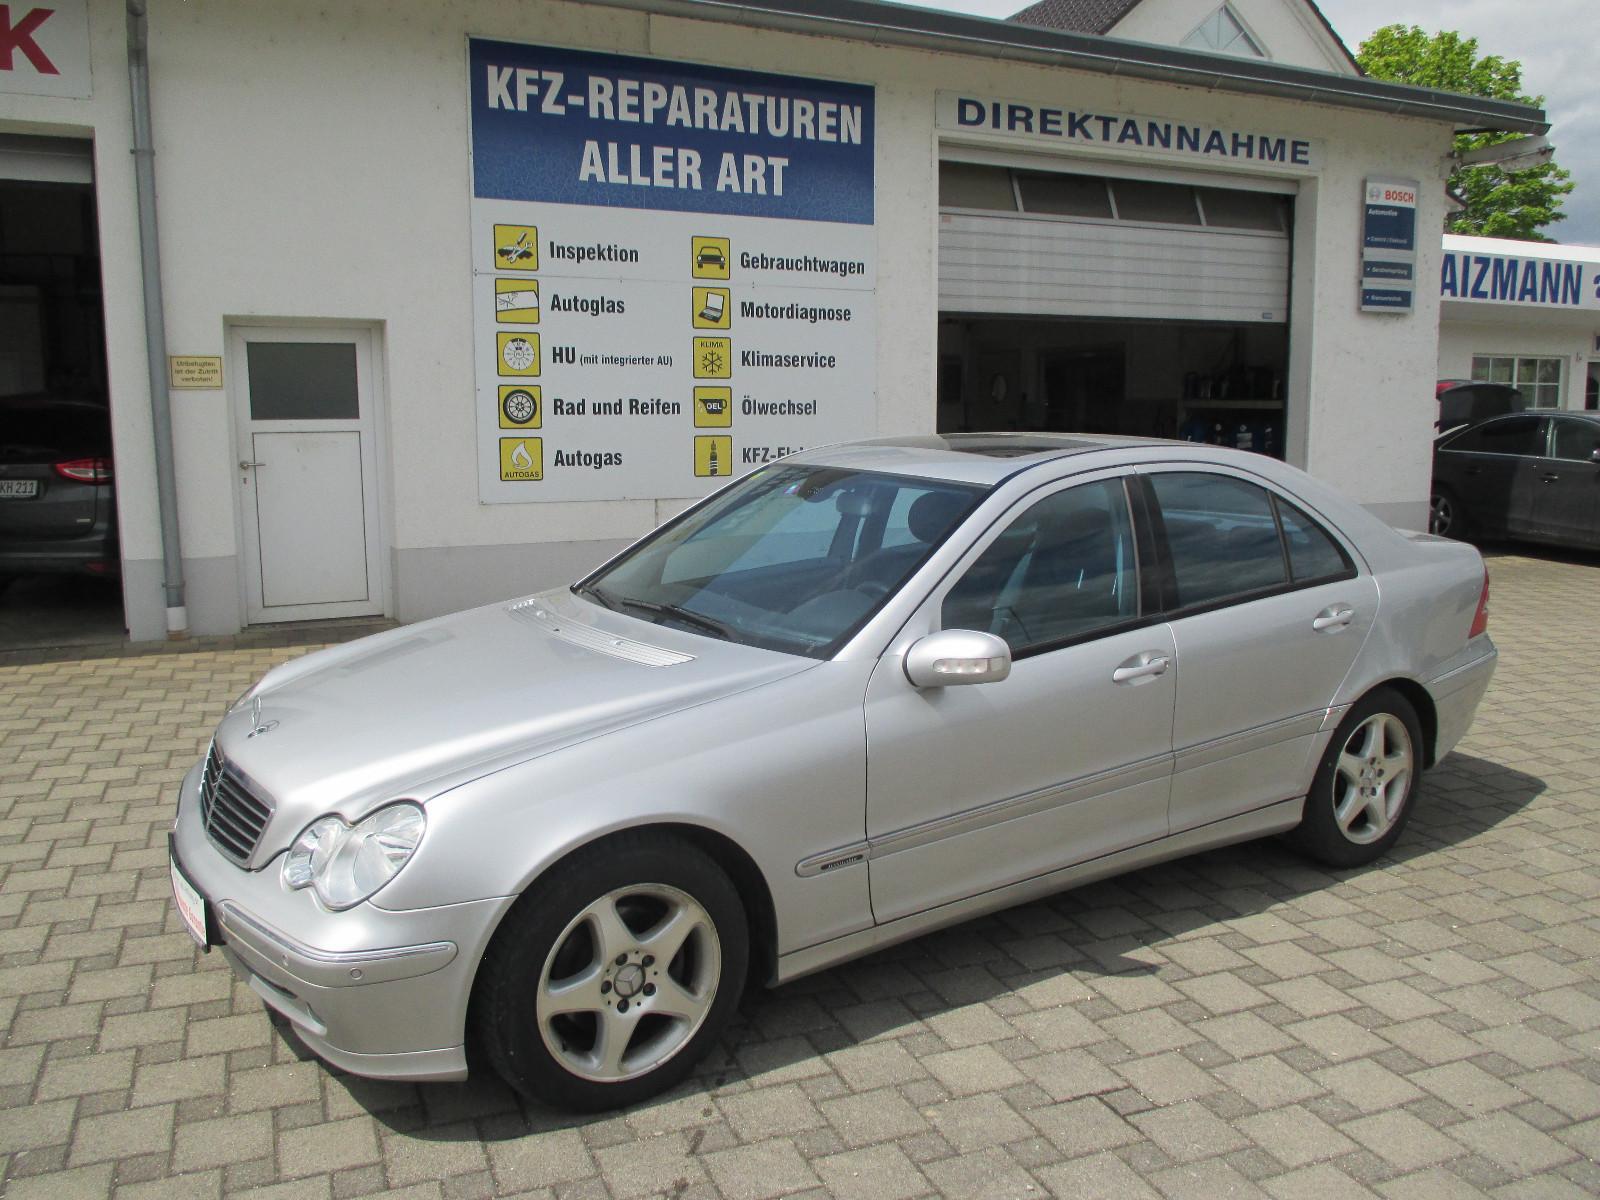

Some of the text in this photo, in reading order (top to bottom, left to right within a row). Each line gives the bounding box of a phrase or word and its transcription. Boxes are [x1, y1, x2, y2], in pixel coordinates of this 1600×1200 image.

[486, 64, 862, 145] KFZ-REPARATUREN
[957, 98, 1310, 165] DIREKTANNAHME
[579, 140, 789, 197] ALLER ART
[1385, 190, 1414, 203] BOSCH
[550, 241, 639, 264] Inspektion
[740, 252, 865, 277] Gebrauchtwagen
[1440, 253, 1583, 305] AIZMANN
[551, 294, 625, 316] Autoglas
[741, 302, 851, 323] Motordiagnose
[700, 341, 724, 349] KLIMA
[552, 347, 673, 367] HU (mit integrierter AU)
[741, 350, 836, 368] Klimaservice
[553, 398, 681, 416] Rad und Reifen
[742, 395, 817, 415] Ölwechsel
[554, 449, 623, 469] Autogas
[742, 446, 804, 463] KFZ-El
